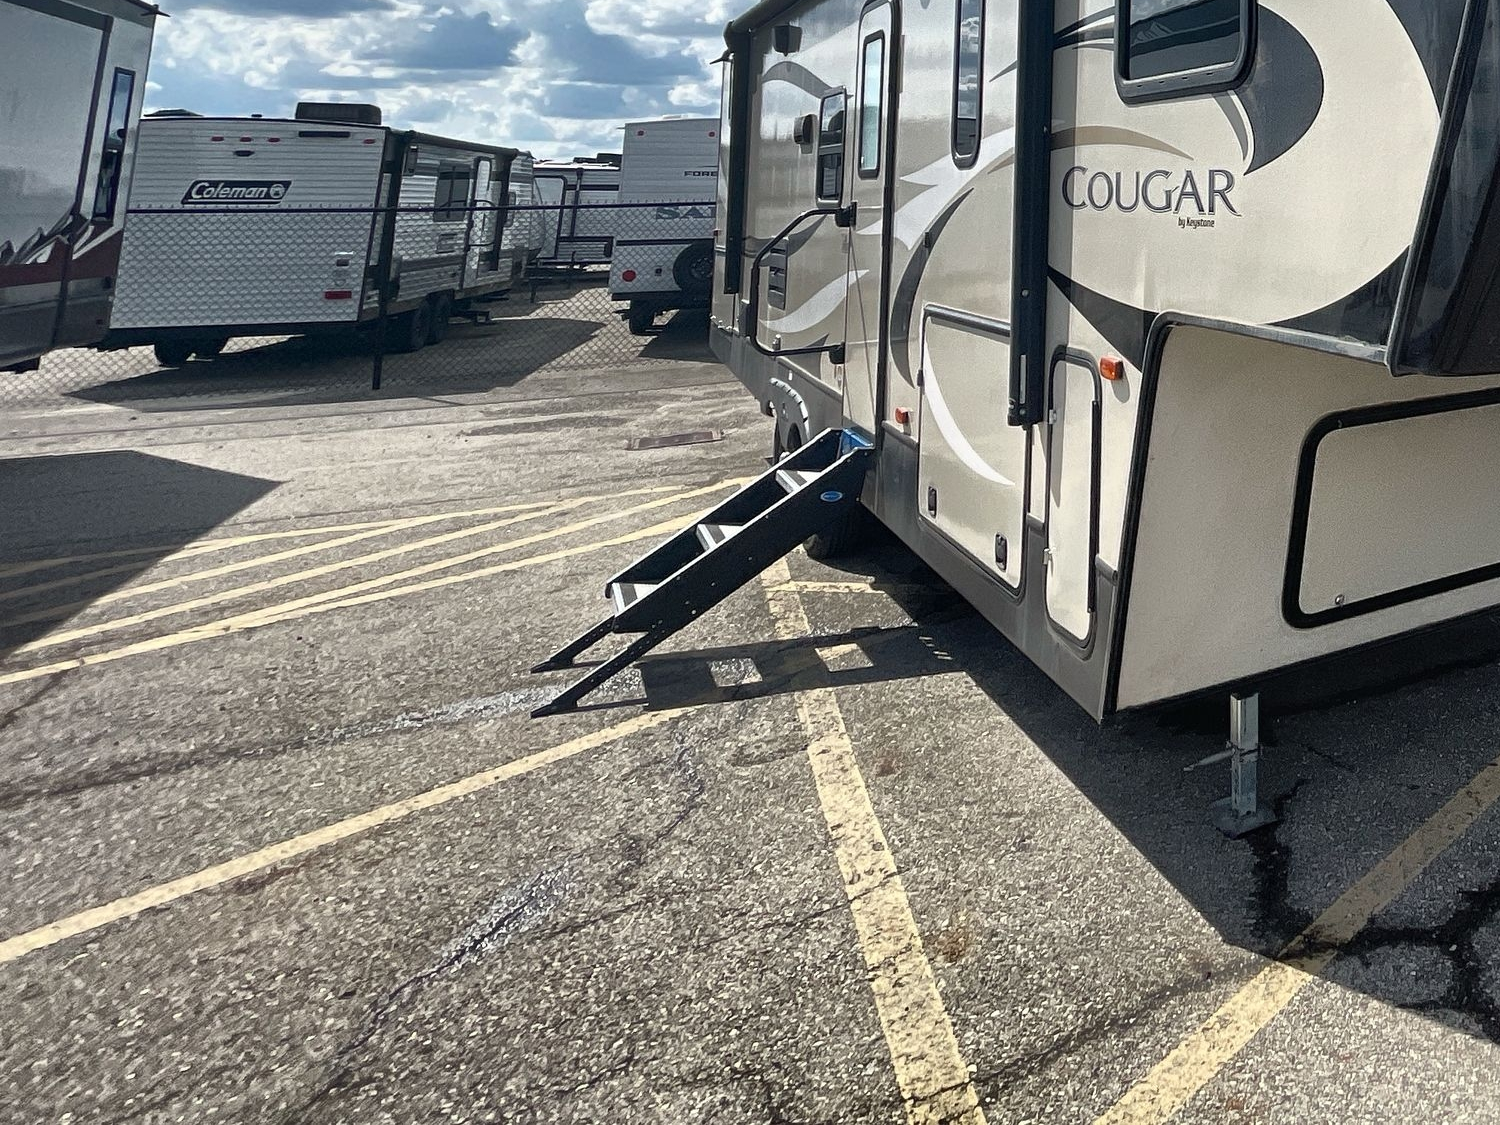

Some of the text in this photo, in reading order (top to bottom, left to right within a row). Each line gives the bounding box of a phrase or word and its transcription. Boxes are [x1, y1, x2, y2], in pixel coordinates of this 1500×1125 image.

[191, 182, 268, 199] Coleman
[1061, 165, 1242, 217] COUGAR
[1178, 217, 1215, 229] by Keystone
